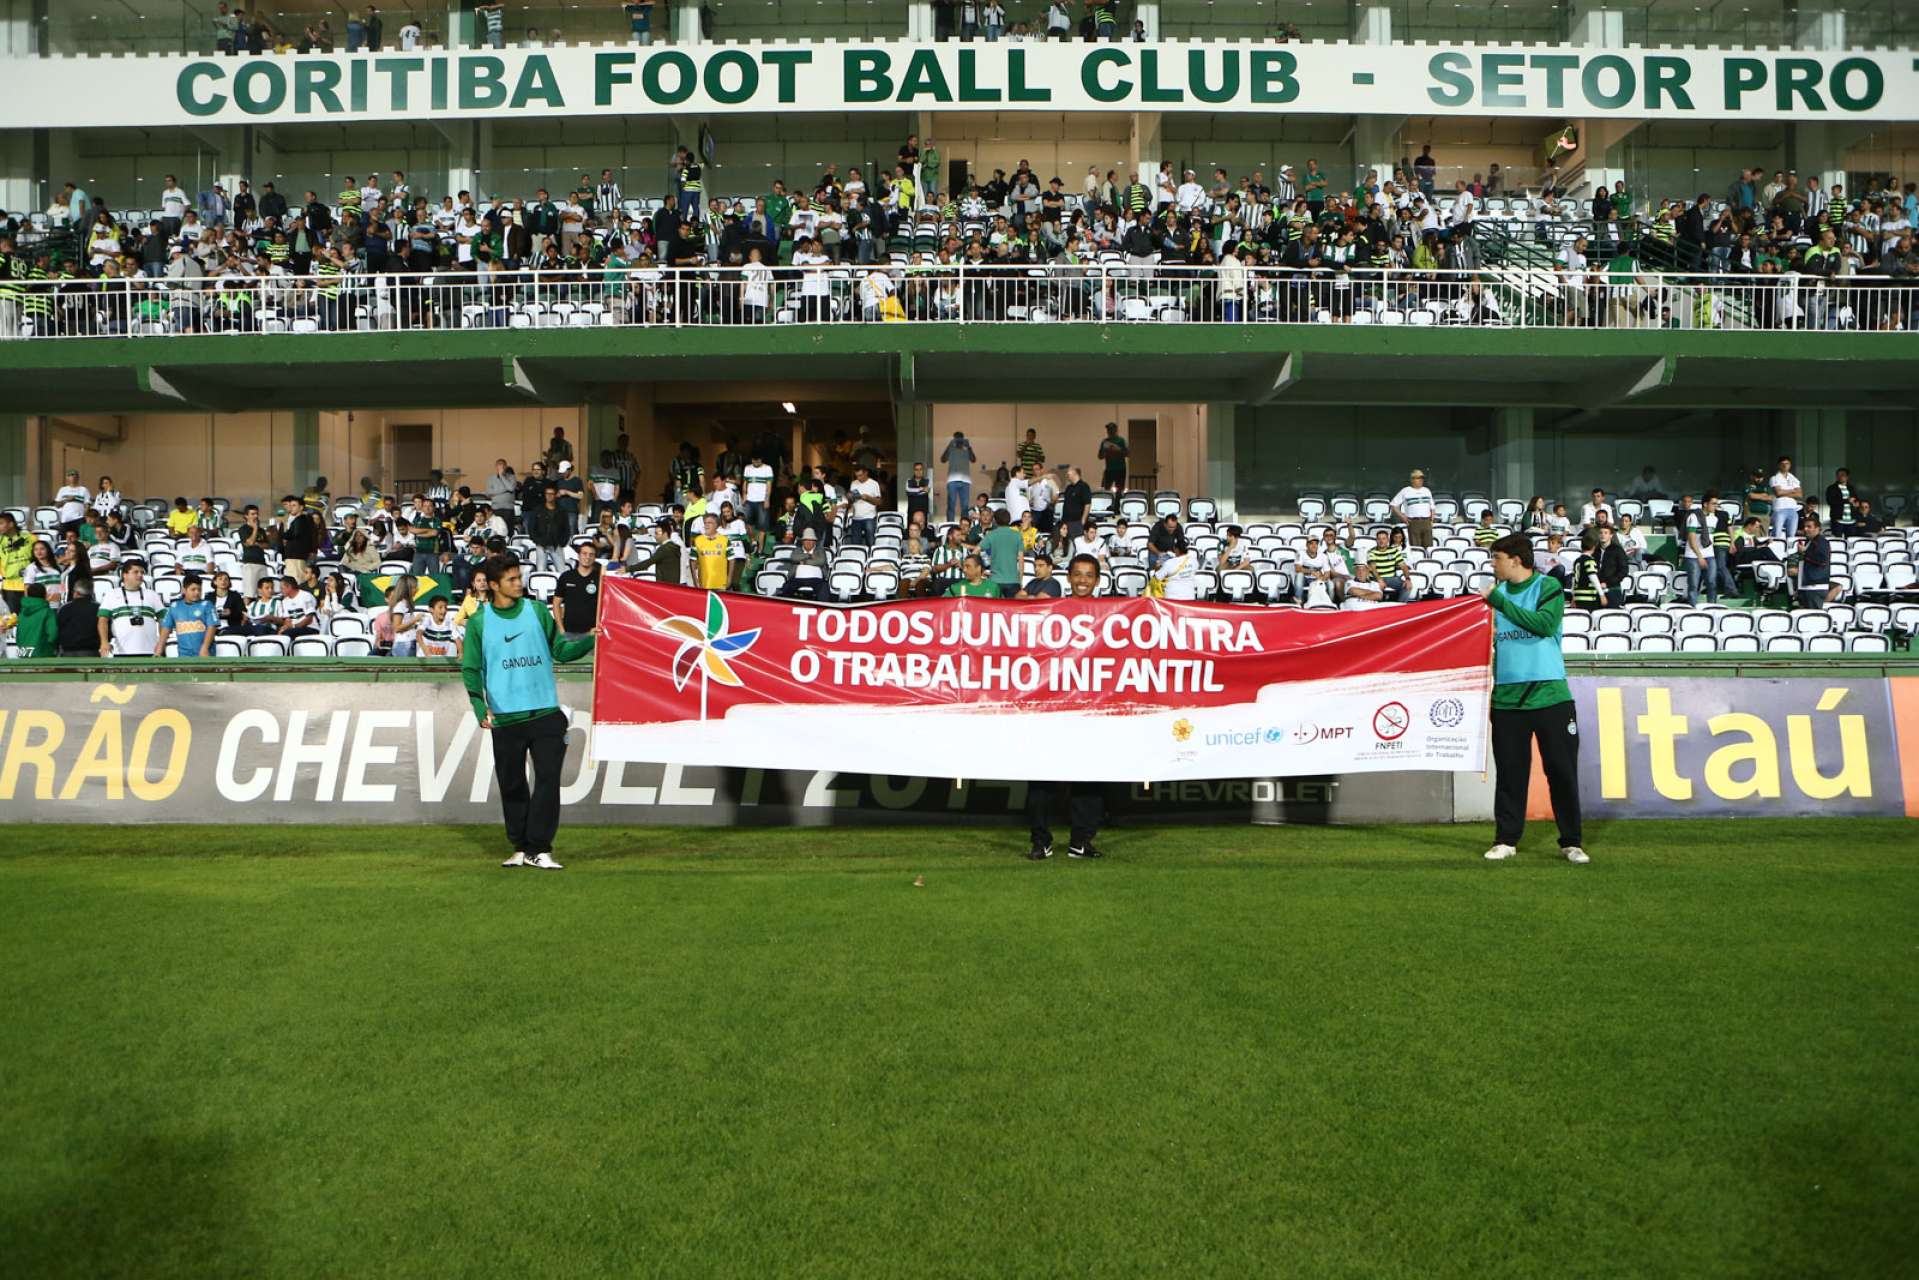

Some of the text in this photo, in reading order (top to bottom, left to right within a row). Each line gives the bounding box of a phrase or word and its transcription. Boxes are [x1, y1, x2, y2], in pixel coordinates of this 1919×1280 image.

[177, 47, 1885, 118] CORITIBA FOOT BALL CLUB - SETOR PRO
[792, 606, 1265, 653] TODOS JUNTOS CONTRA
[502, 655, 543, 670] GANDULA
[790, 649, 1225, 693] O TRABALHO INFANTIL
[1205, 727, 1262, 746] unicef
[1320, 727, 1355, 740] MPT
[1596, 687, 1873, 801] Itaú
[1375, 741, 1403, 750] FNPETI
[1131, 781, 1340, 802] CHEVROLET
